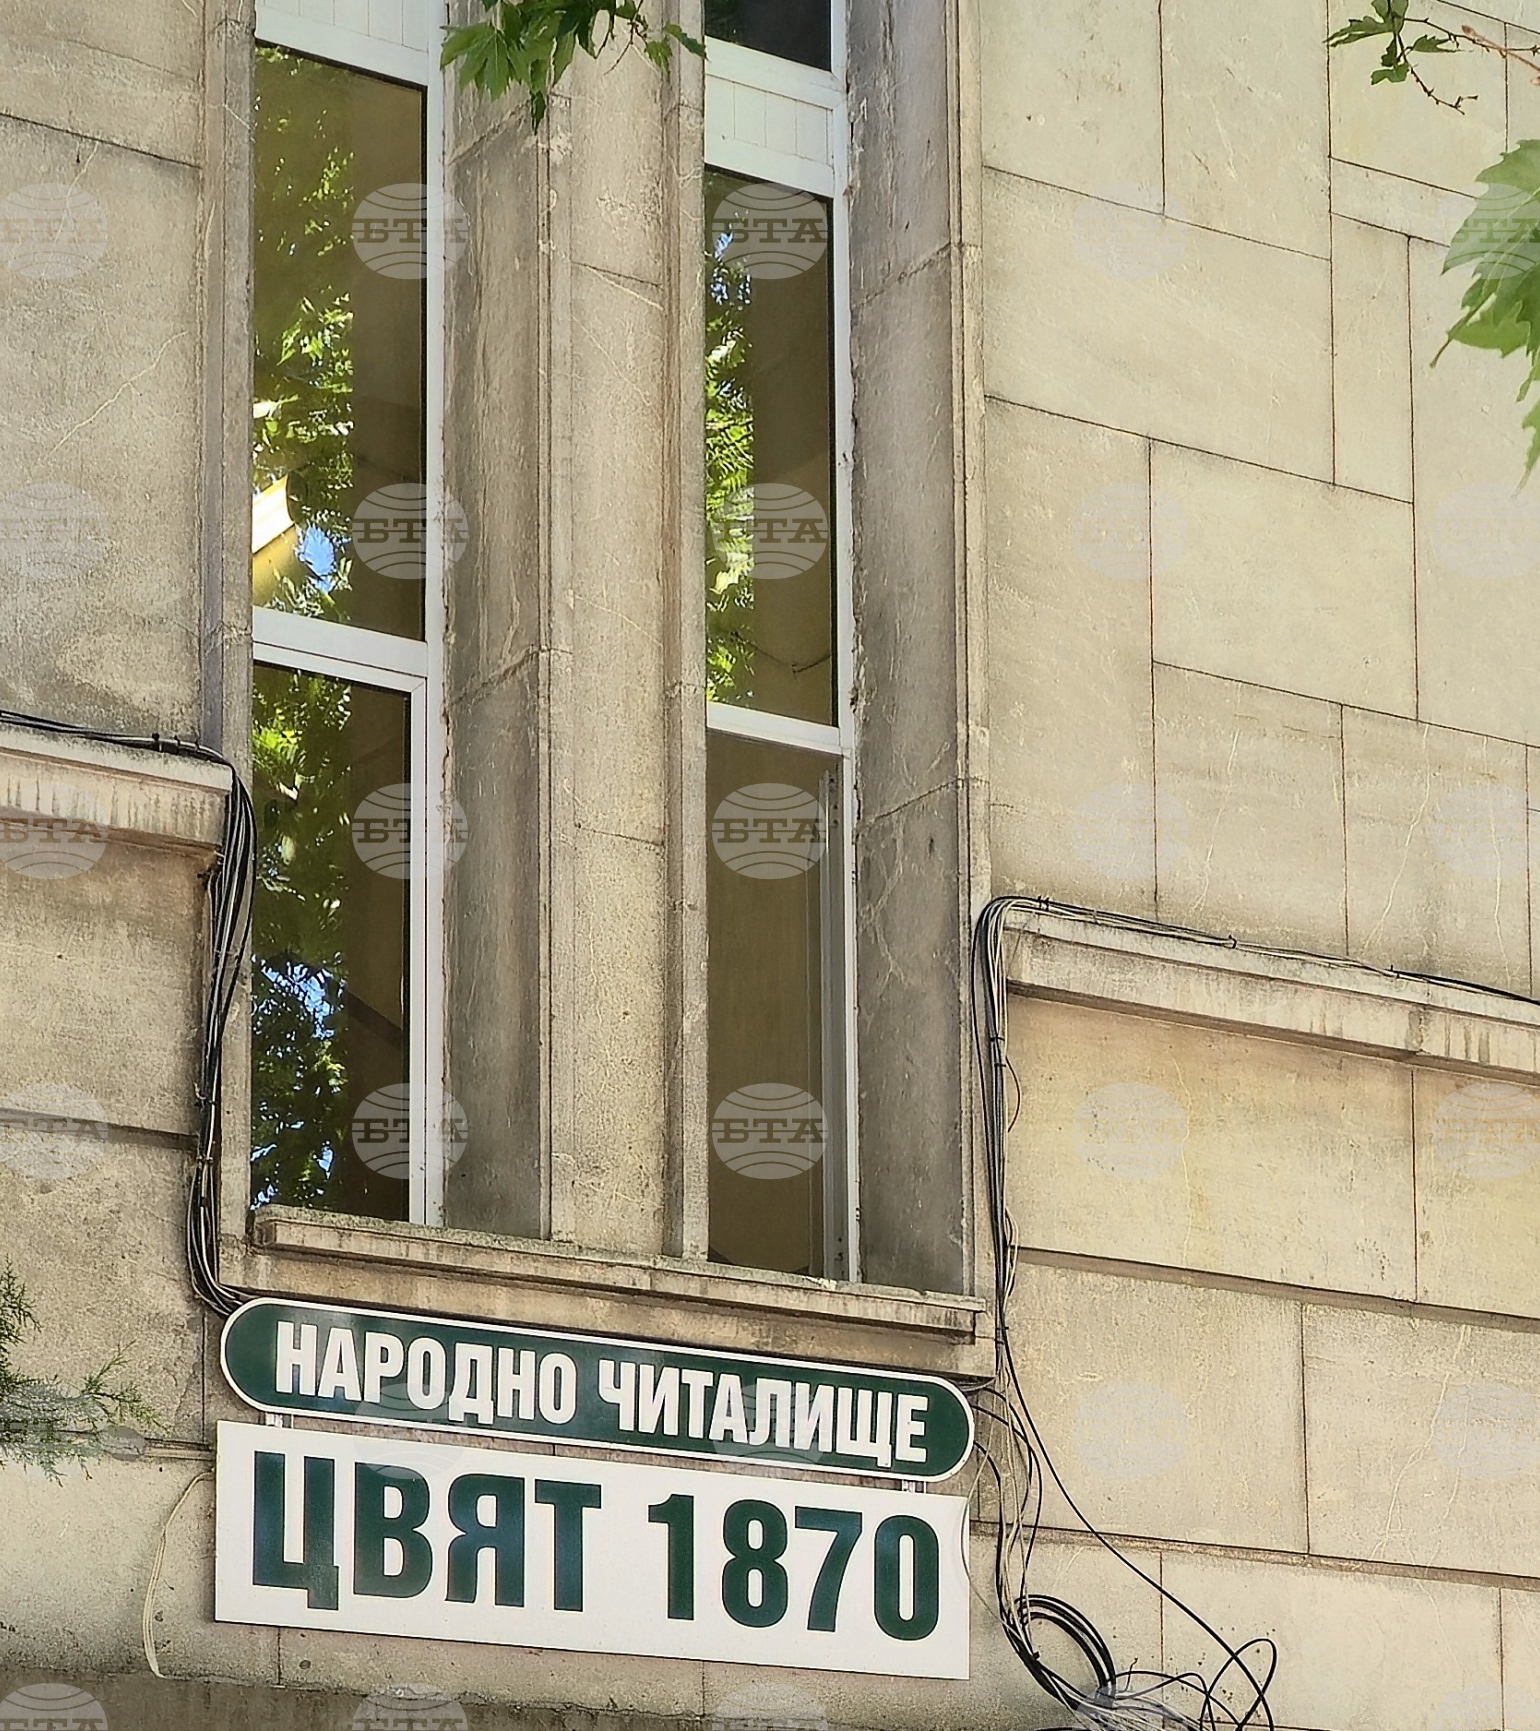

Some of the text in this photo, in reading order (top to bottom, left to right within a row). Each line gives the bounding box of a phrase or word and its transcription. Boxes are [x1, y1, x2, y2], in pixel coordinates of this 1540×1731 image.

[274, 1321, 929, 1466] НАРОДНО ЧИТАЛИЩЕ
[252, 1450, 942, 1641] ЦВЯТ 1870
